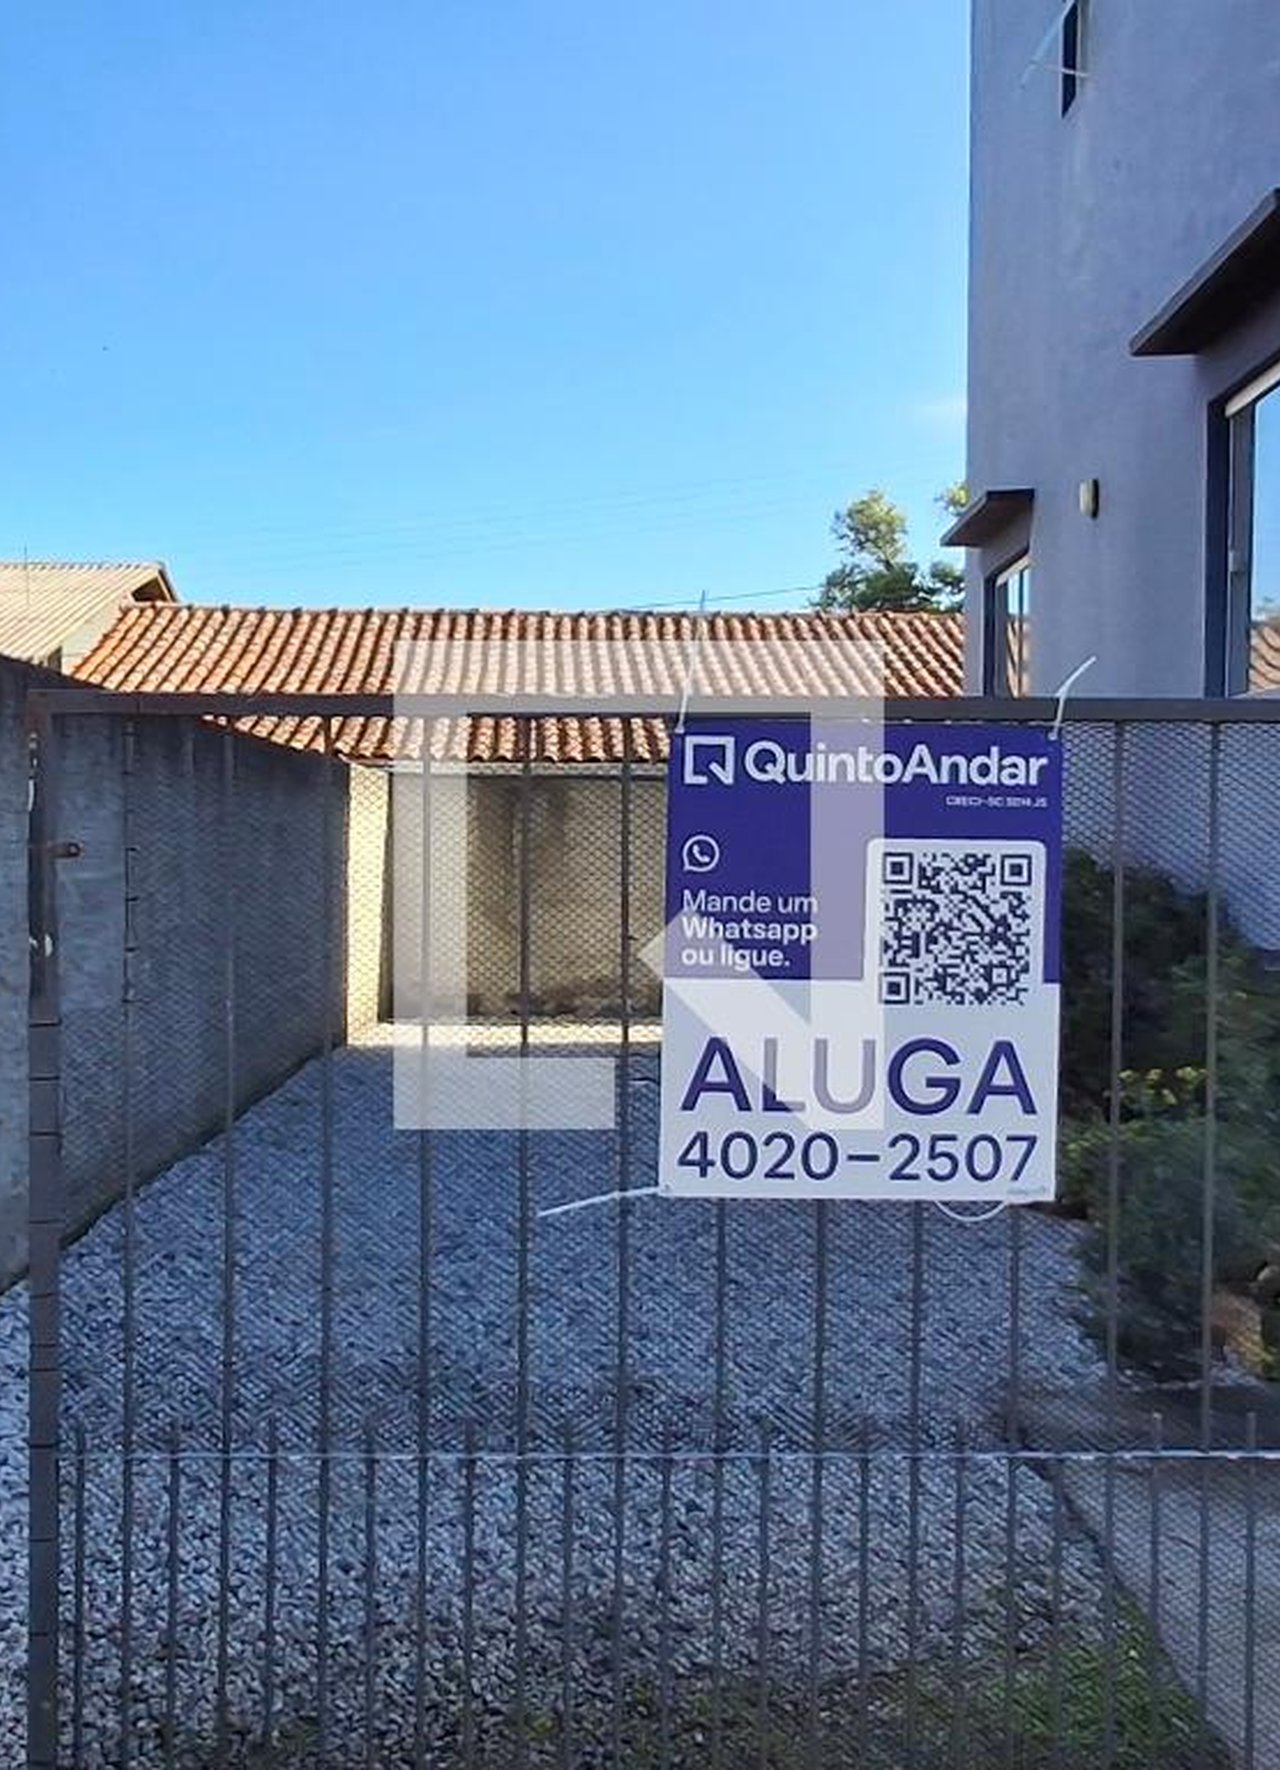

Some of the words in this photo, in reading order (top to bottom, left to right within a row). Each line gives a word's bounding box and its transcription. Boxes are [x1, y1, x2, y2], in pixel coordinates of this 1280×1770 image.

[744, 740, 1048, 786] QuintoAndar
[682, 889, 771, 913] Mande
[778, 896, 818, 913] um
[682, 917, 818, 945] Whatsapp
[681, 949, 715, 965] ou
[721, 943, 791, 971] ligue.
[680, 1036, 1038, 1115] ALUGA
[677, 1130, 1039, 1183] 4020-2507
